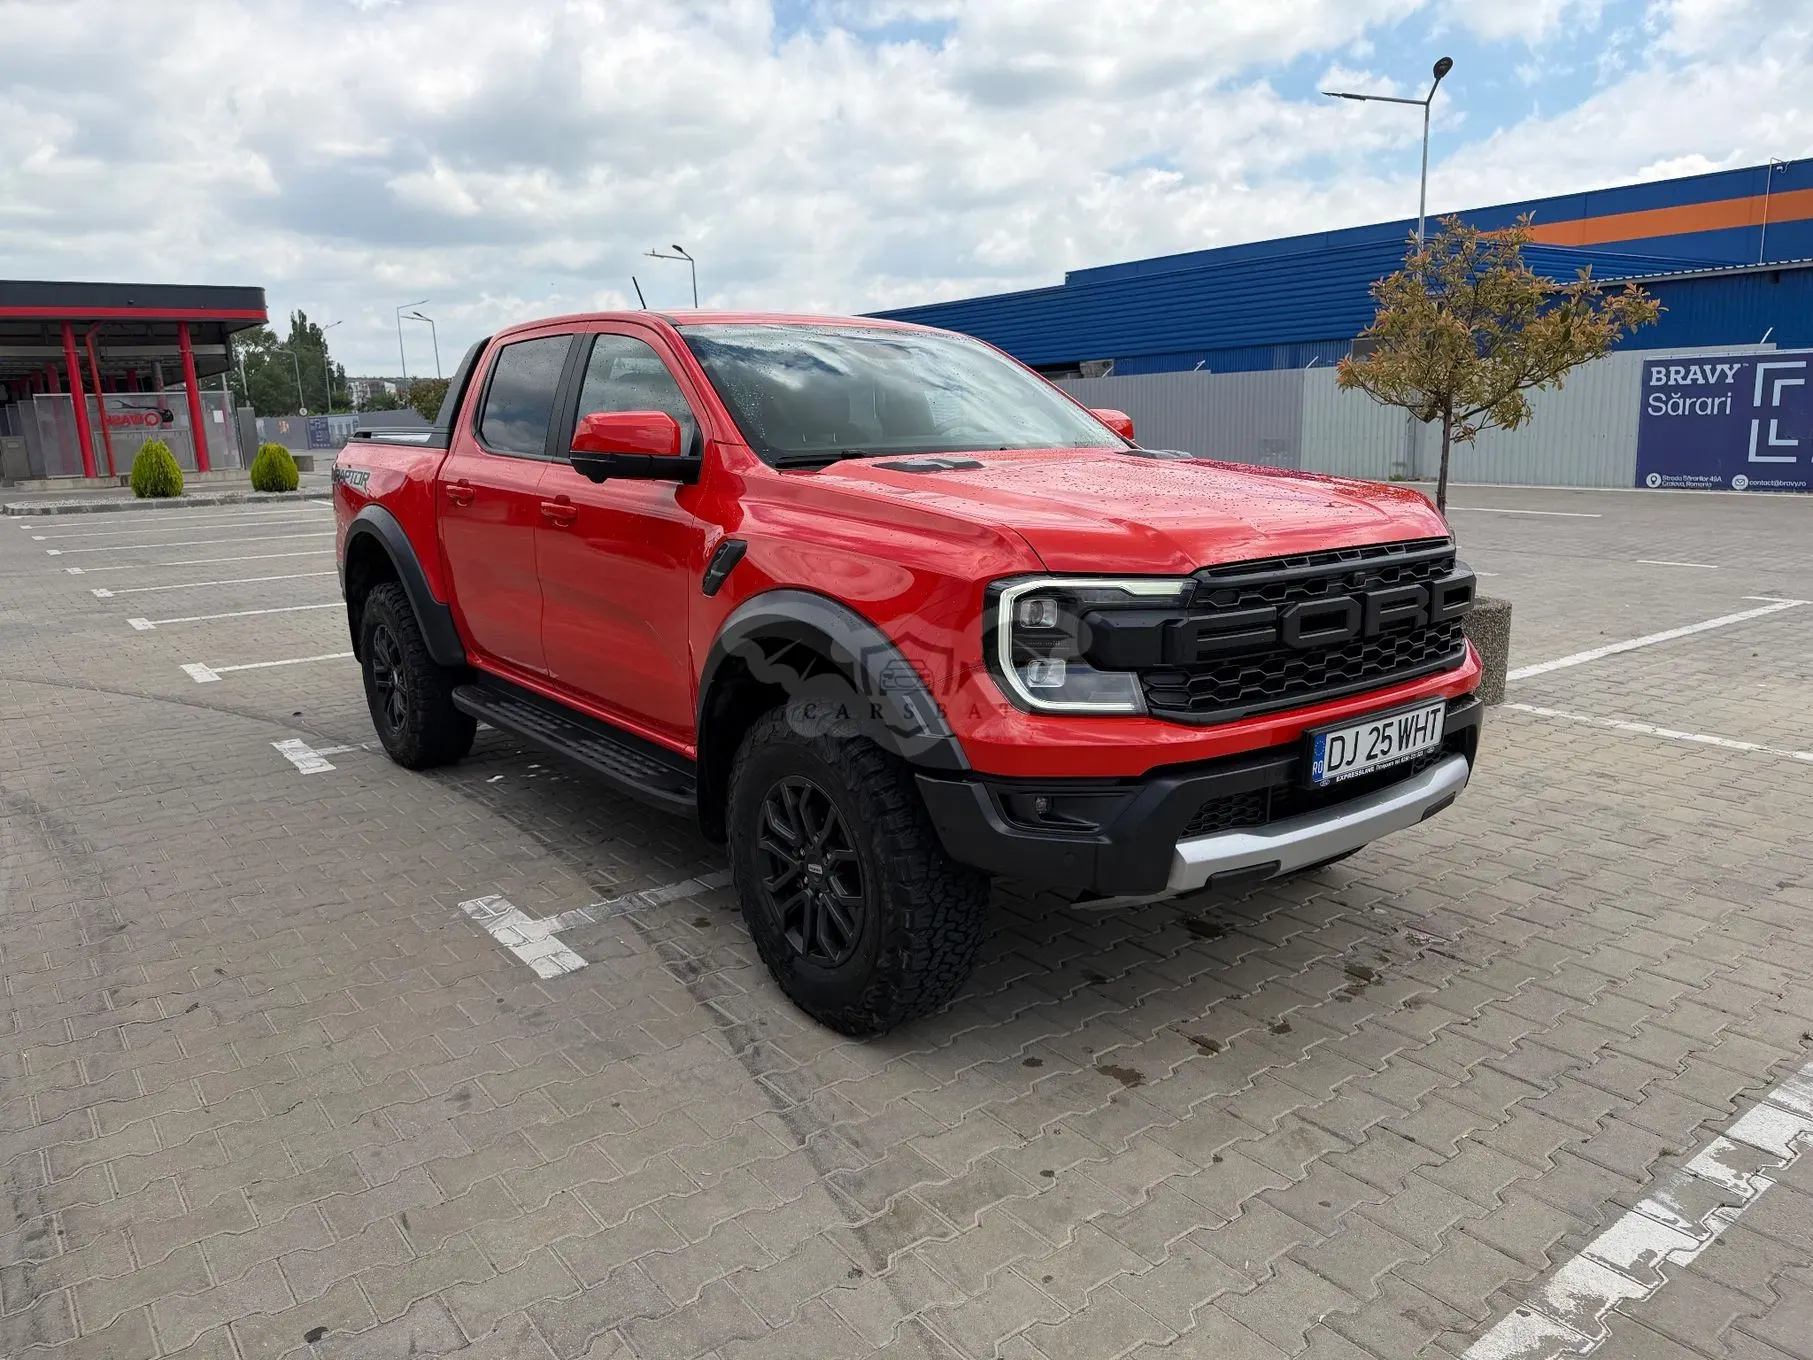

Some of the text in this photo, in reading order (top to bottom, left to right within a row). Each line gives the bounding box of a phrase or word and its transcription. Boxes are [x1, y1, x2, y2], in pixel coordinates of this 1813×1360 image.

[1650, 363, 1741, 386] BRAVY
[1647, 392, 1732, 416] Sărari
[1749, 479, 1807, 488] contact@bravy.ro
[1173, 570, 1477, 666] FORD
[1327, 731, 1360, 772] DJ
[1366, 721, 1394, 761] 25
[1398, 707, 1441, 751] WHT
[1312, 760, 1323, 776] RO
